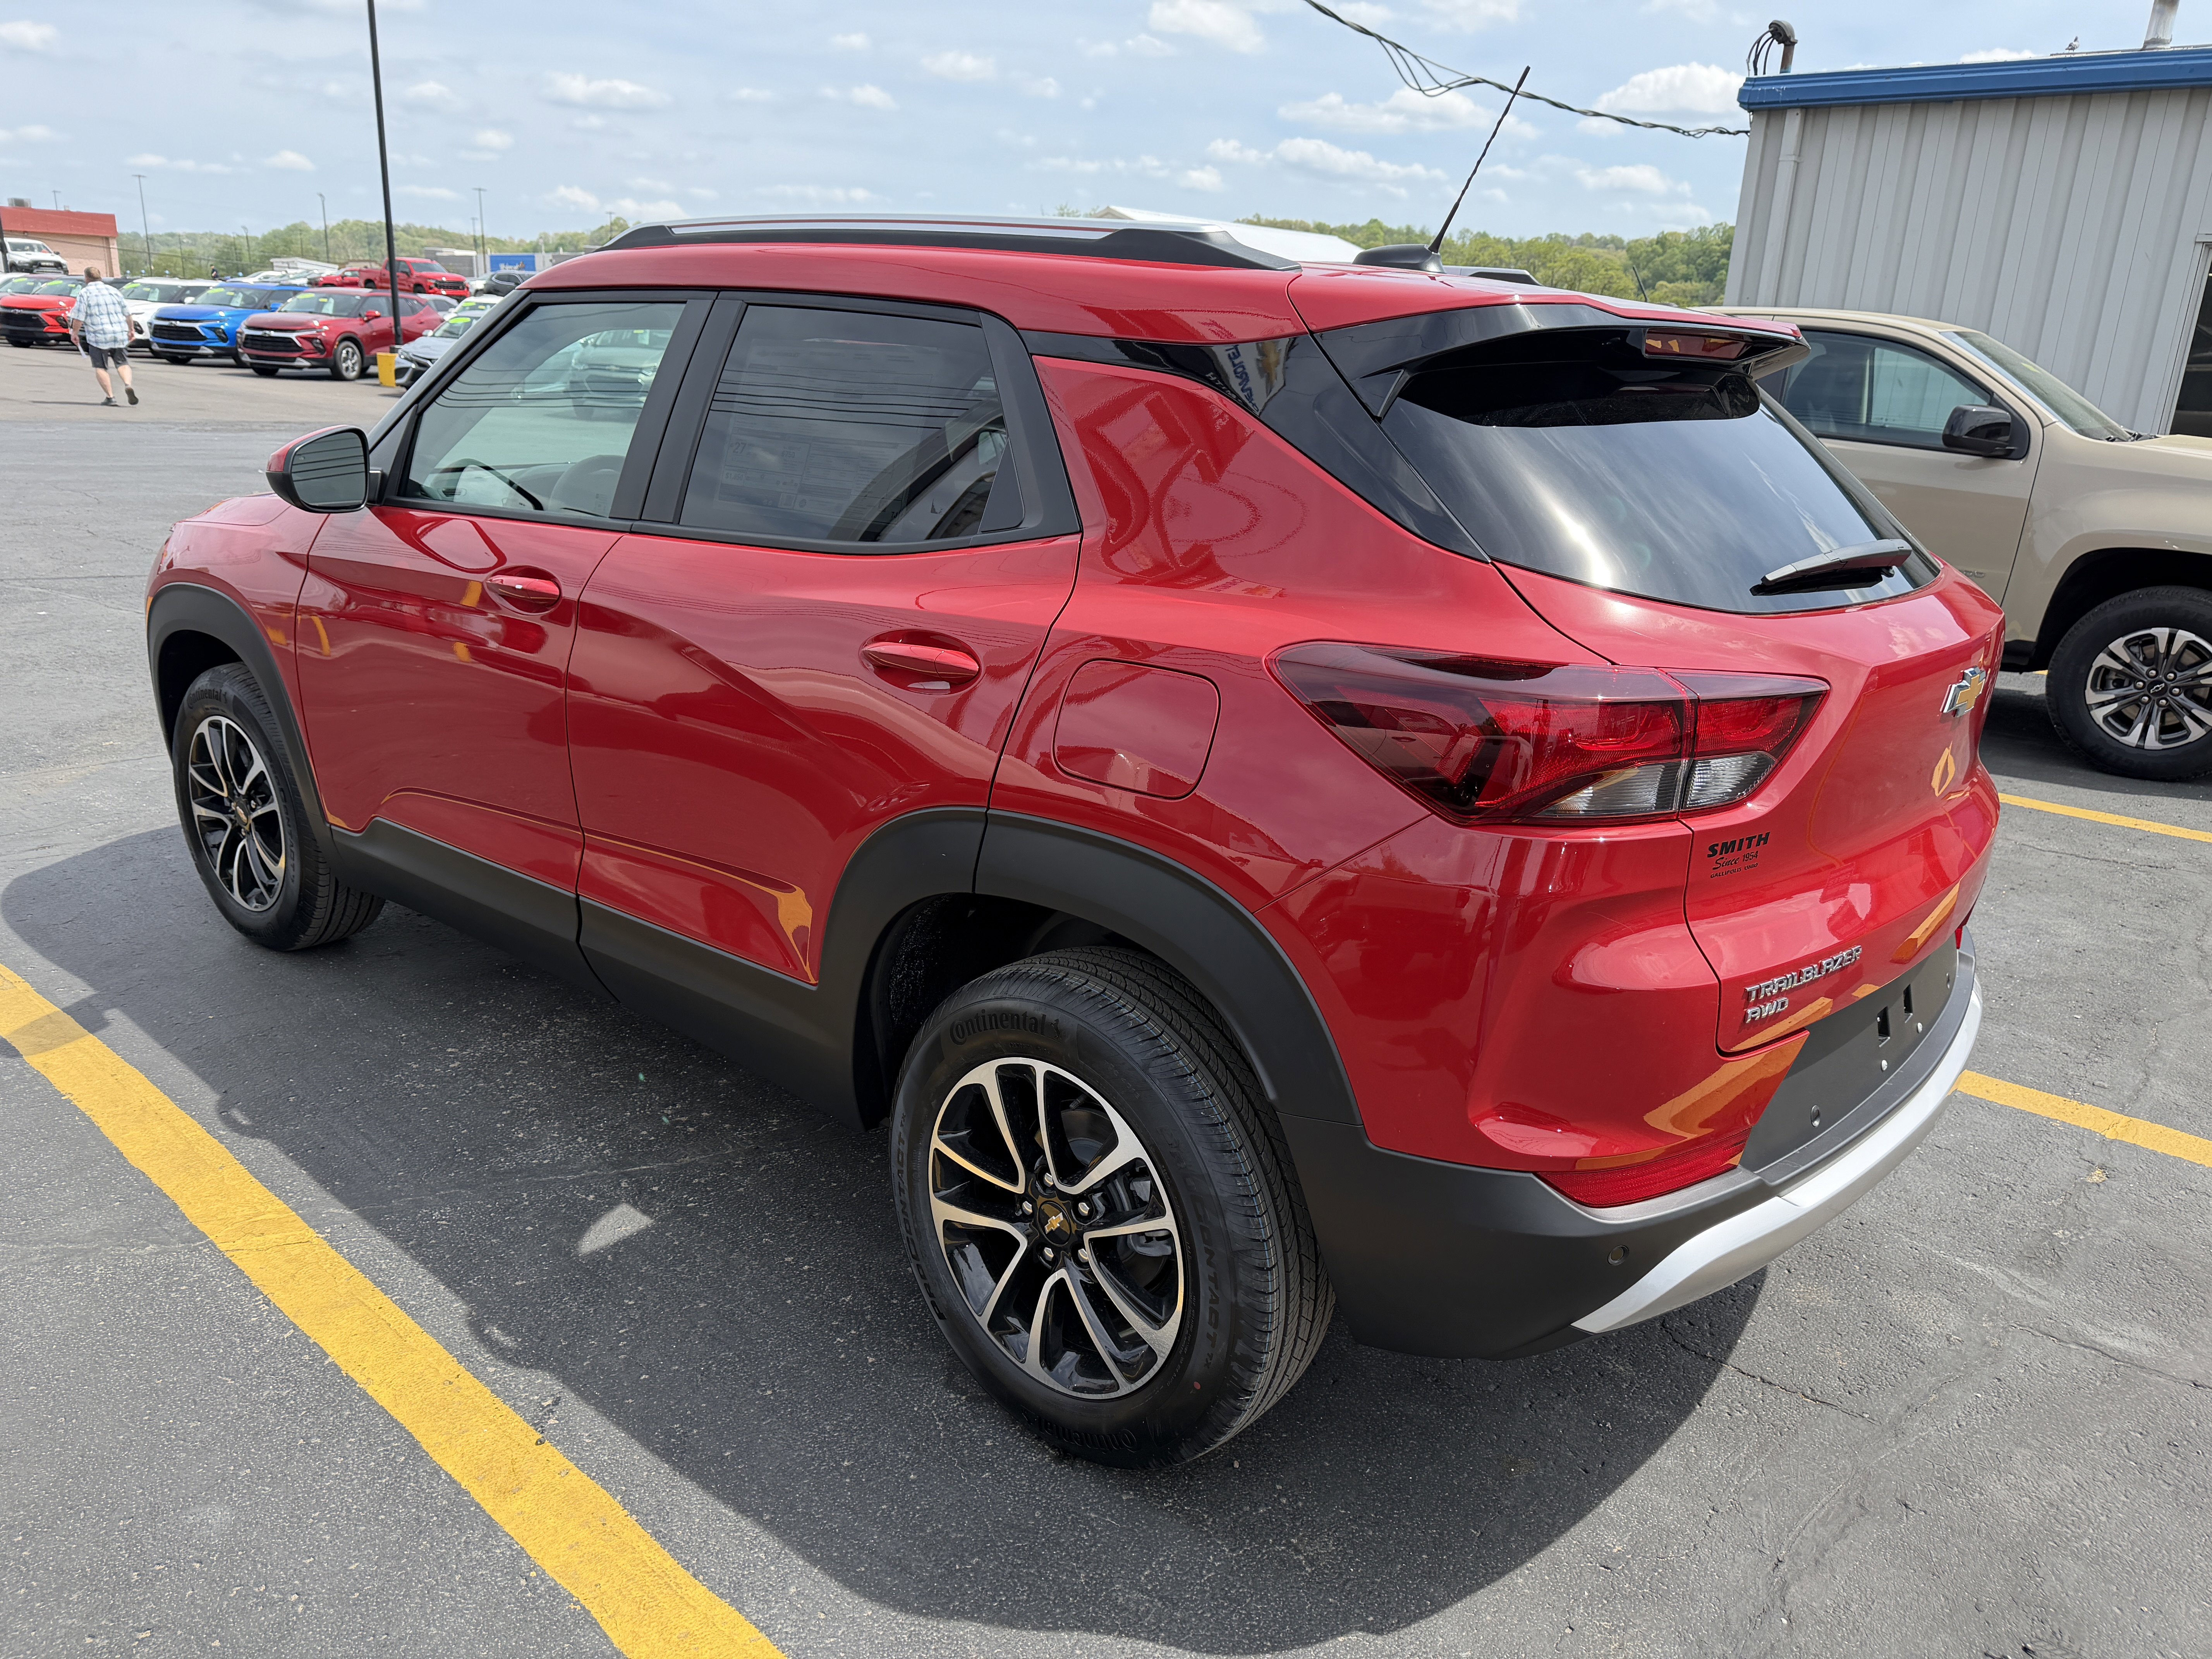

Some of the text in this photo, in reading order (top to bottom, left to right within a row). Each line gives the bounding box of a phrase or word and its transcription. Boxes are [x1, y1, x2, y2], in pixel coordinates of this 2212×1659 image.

[1707, 831, 1771, 858] SMITH
[1710, 867, 1741, 878] GALLIPOLIS
[1712, 850, 1759, 870] Since 1954
[1744, 945, 1862, 1002] TRAILBLAZER
[1744, 996, 1789, 1024] AWD
[949, 1009, 1046, 1046] Continental
[896, 1133, 947, 1321] PROCONTACT
